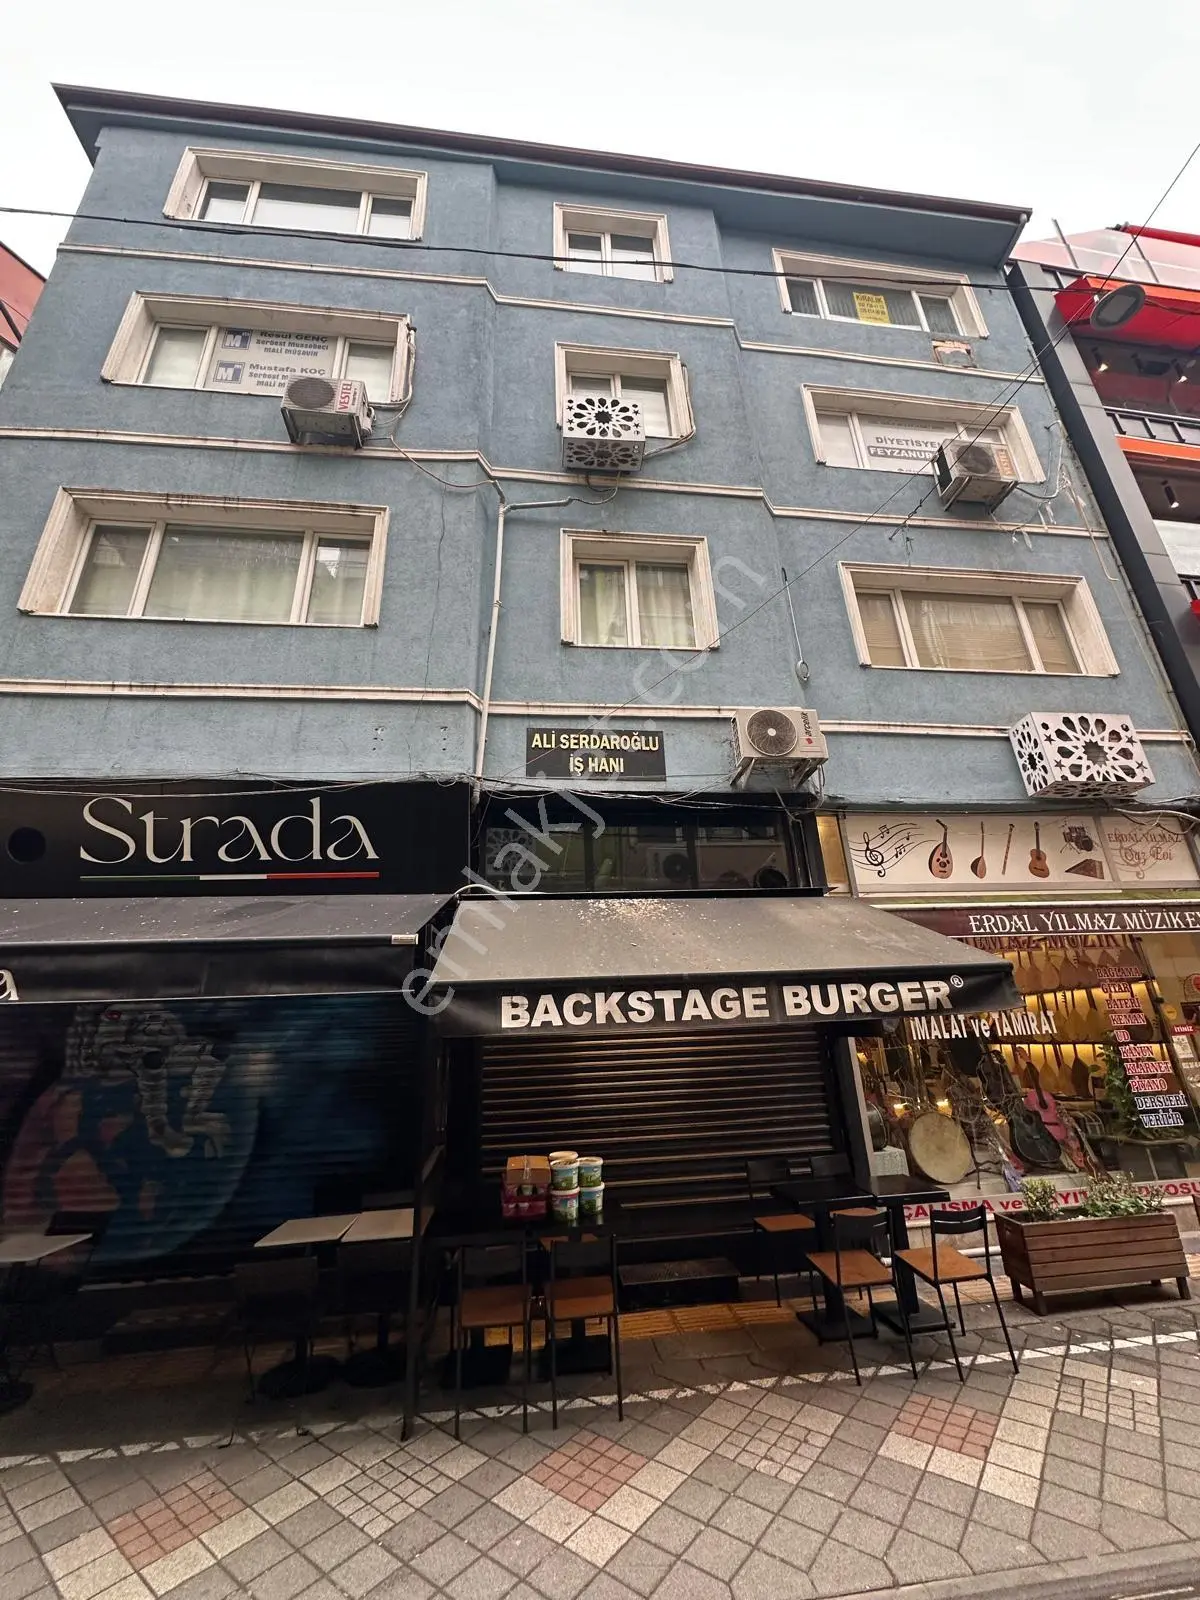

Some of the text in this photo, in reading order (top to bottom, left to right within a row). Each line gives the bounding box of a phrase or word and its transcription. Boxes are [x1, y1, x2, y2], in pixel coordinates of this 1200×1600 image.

[249, 364, 326, 376] Mustafa KOÇ
[338, 382, 353, 411] VESTEL
[875, 436, 942, 449] DİYETİSYE
[869, 447, 933, 460] FEYZANUR
[531, 730, 660, 751] ALİ SERDAROĞLU
[569, 753, 624, 777] İŞ HANI
[79, 796, 380, 865] Strada
[968, 913, 1038, 934] ERDAL
[1039, 911, 1122, 932] YILMAZ
[1101, 980, 1130, 994] GİTAR
[501, 980, 954, 1029] BACKSTAGE BURGER
[1105, 995, 1141, 1009] BATERİ
[970, 1018, 991, 1038] ve
[991, 1010, 1058, 1037] TAMİRAT
[1110, 1012, 1147, 1025] KEMAN
[1114, 1030, 1131, 1042] UD
[1120, 1046, 1154, 1058] KANUN
[1125, 1061, 1173, 1075] KLARNET
[1130, 1076, 1168, 1092] PİYANO
[1135, 1091, 1189, 1110] DERSLERİ
[1141, 1109, 1184, 1128] VERİLİR
[999, 1198, 1023, 1211] ve
